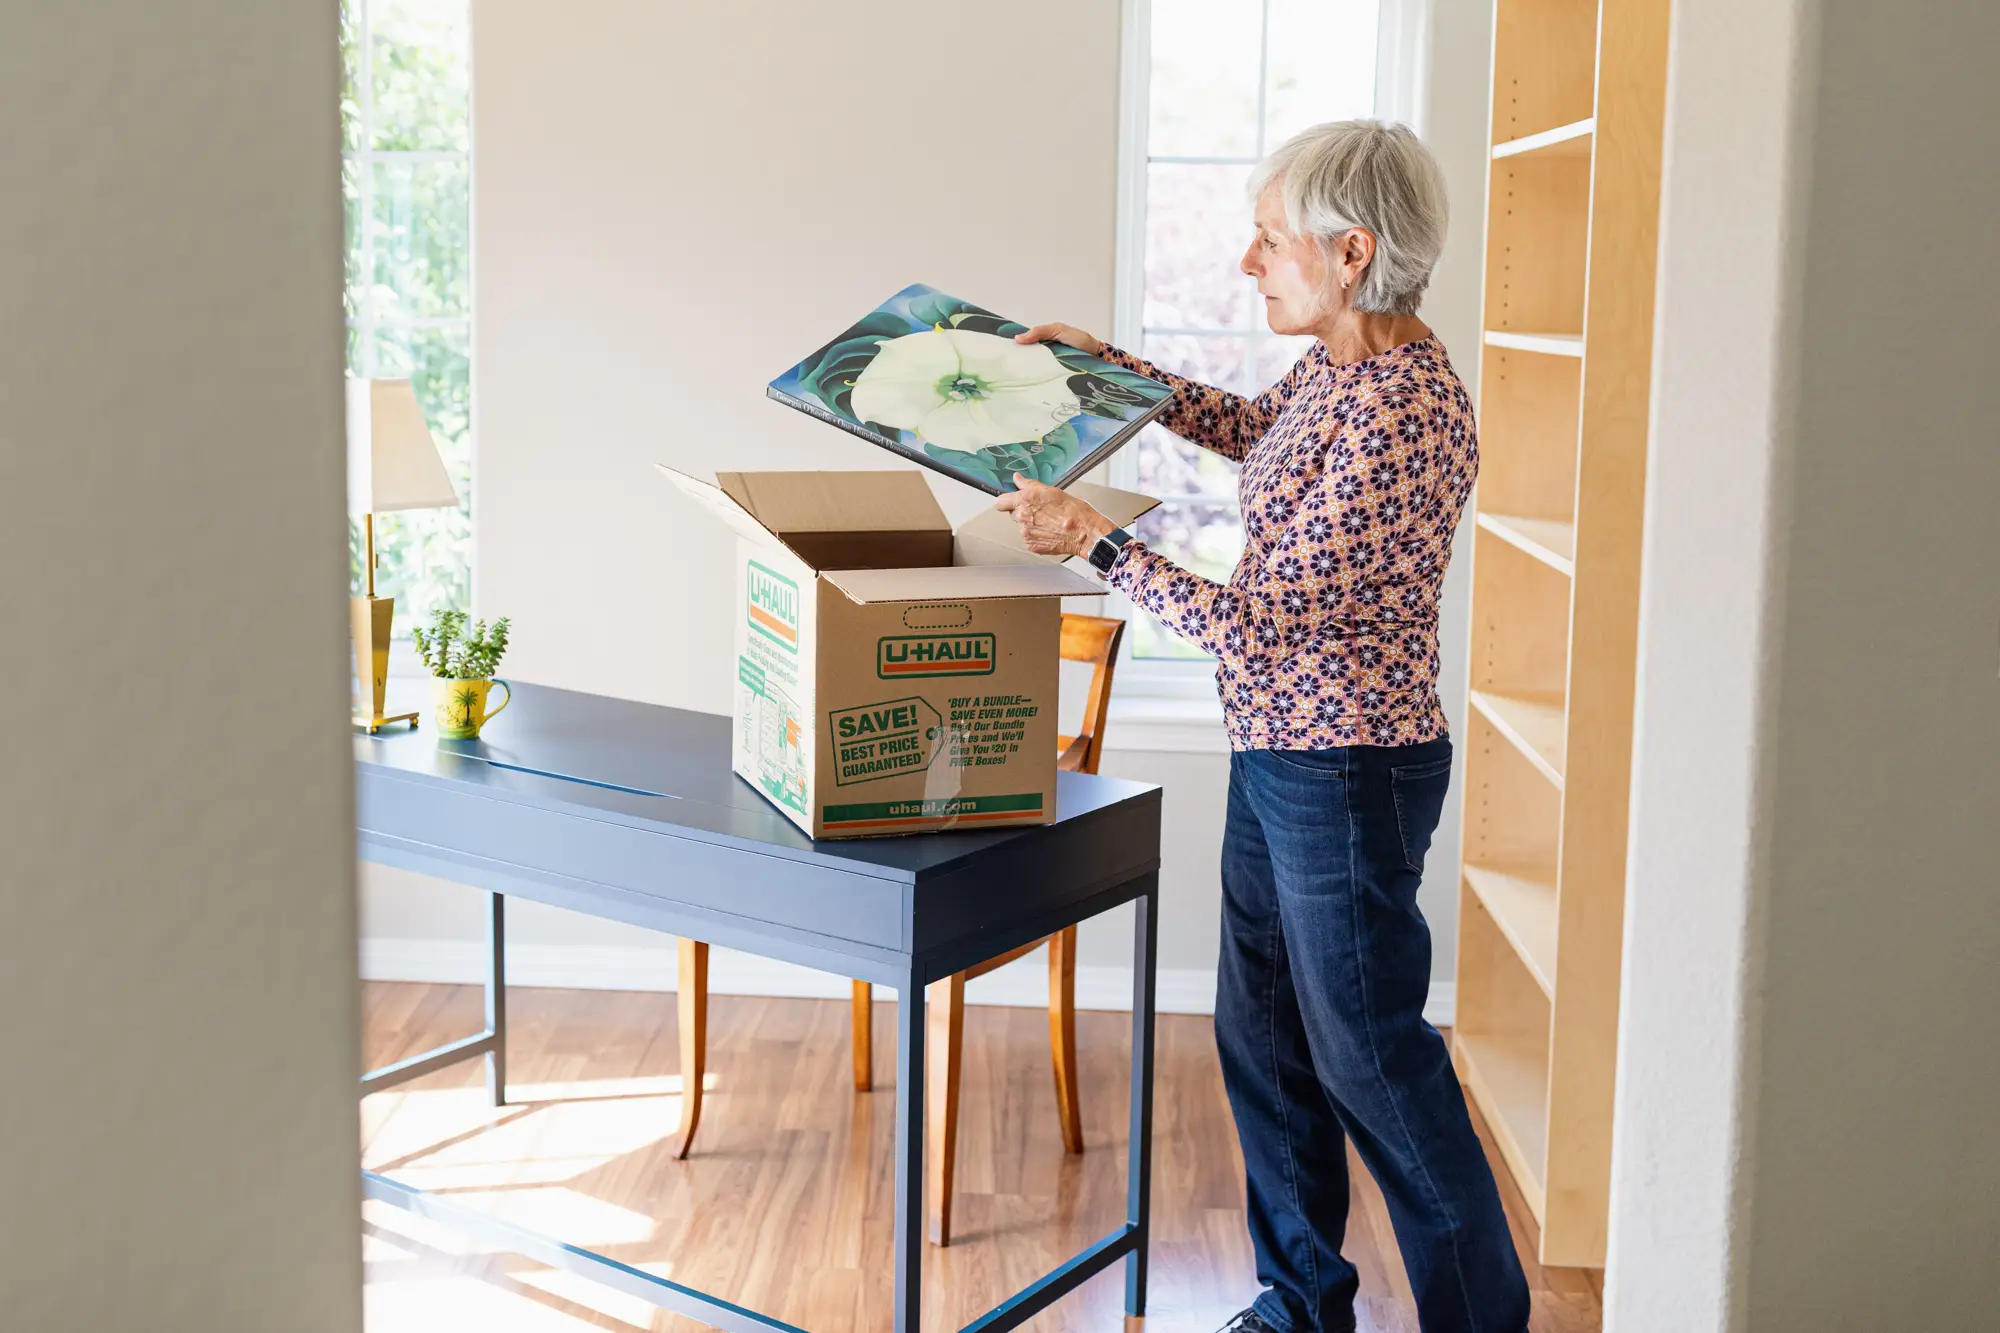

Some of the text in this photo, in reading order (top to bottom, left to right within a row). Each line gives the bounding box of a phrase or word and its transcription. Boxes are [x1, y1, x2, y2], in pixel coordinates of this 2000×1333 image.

[973, 696, 980, 707] A
[950, 707, 1038, 720] SAVE EVEN MORE!
[838, 705, 918, 738] SAVE!
[974, 721, 990, 731] Our
[993, 719, 1025, 730] Bundle
[981, 732, 998, 742] and
[1001, 731, 1024, 741] We'll
[841, 736, 919, 762] BEST PRICE
[950, 745, 970, 755] Give
[973, 744, 989, 754] You
[991, 743, 1007, 753] $20
[975, 755, 1007, 766] Boxes!
[889, 801, 977, 814] uhaul.com
